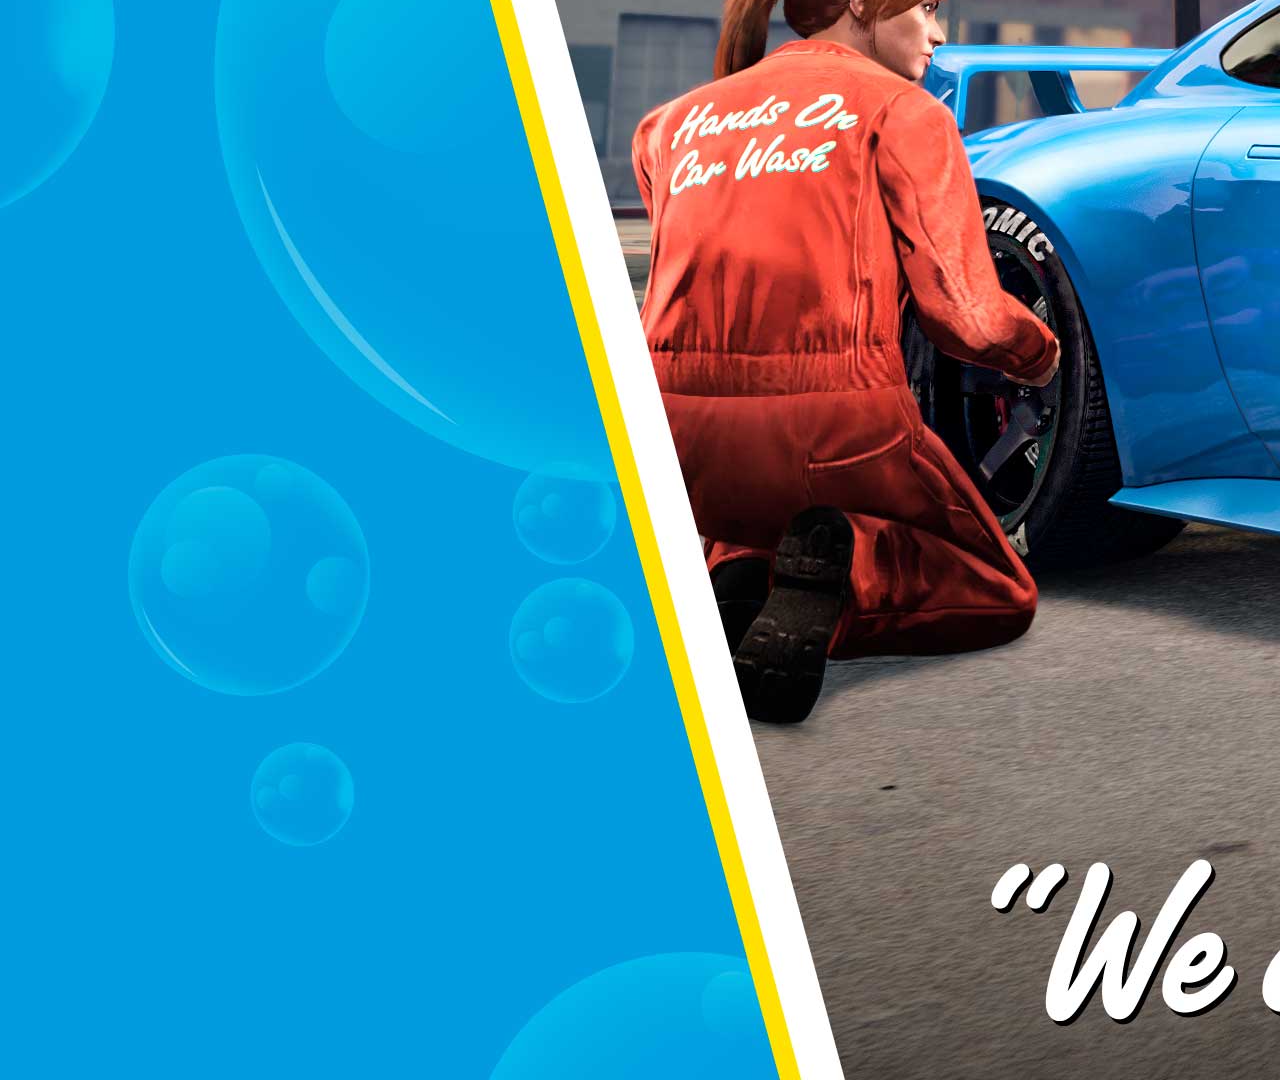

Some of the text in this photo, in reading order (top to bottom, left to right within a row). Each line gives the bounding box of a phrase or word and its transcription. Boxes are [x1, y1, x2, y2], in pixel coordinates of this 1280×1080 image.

[671, 93, 859, 150] Hands On
[670, 134, 837, 195] Car Wash
